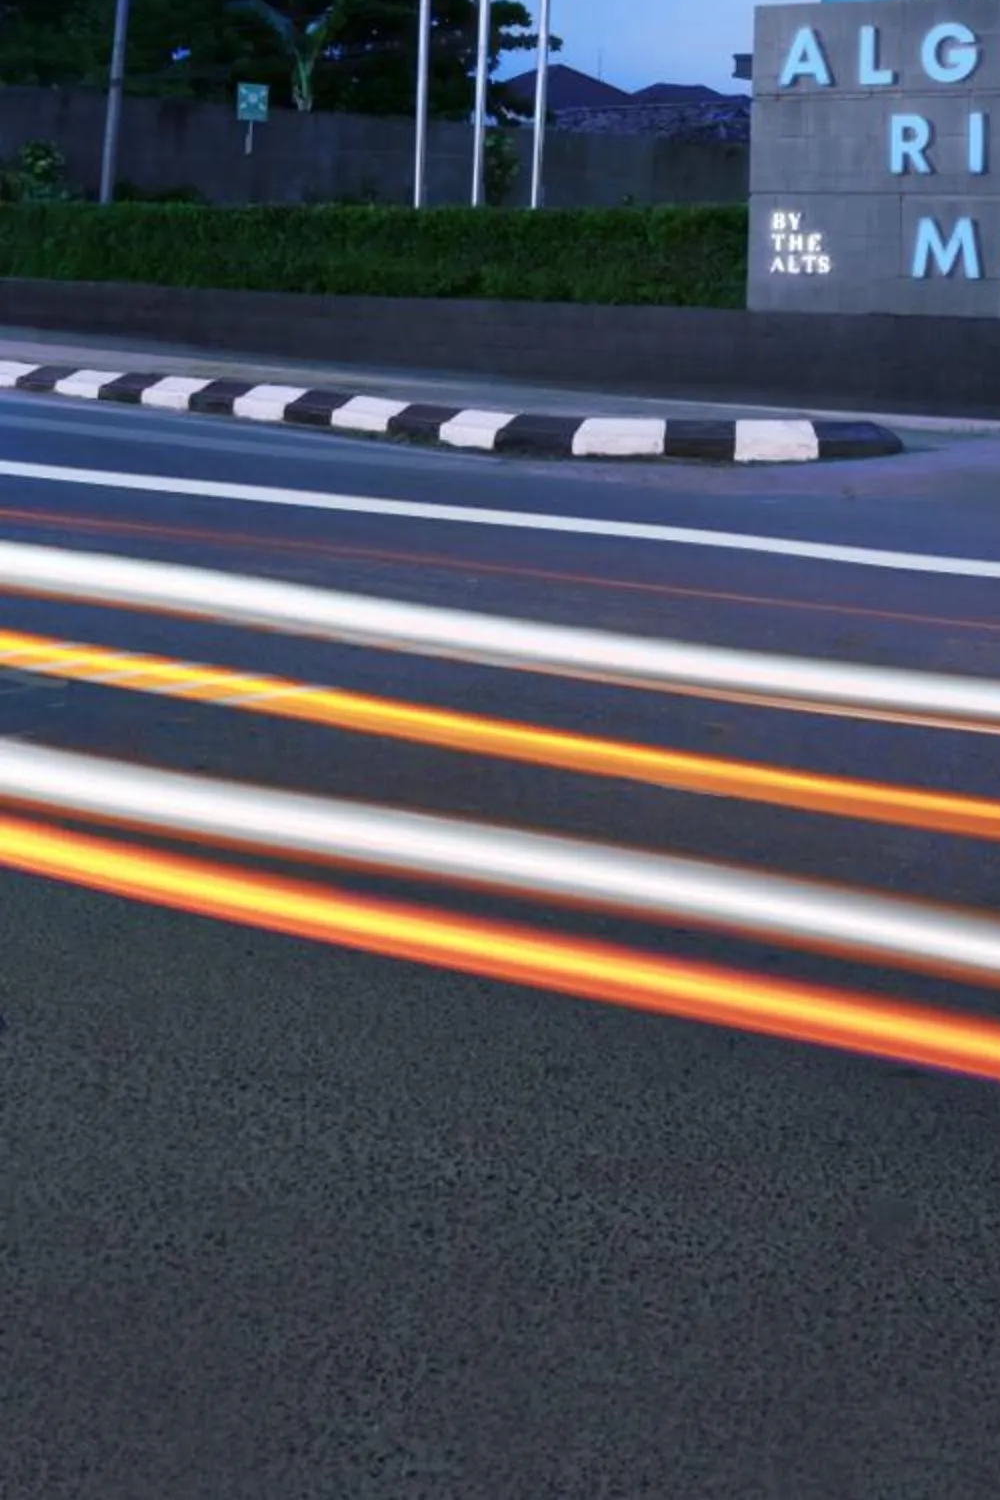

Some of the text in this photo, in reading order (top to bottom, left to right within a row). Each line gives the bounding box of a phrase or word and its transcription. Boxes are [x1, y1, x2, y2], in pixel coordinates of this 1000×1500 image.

[772, 211, 802, 231] BY
[771, 232, 822, 252] THE
[769, 254, 831, 274] ALTS
